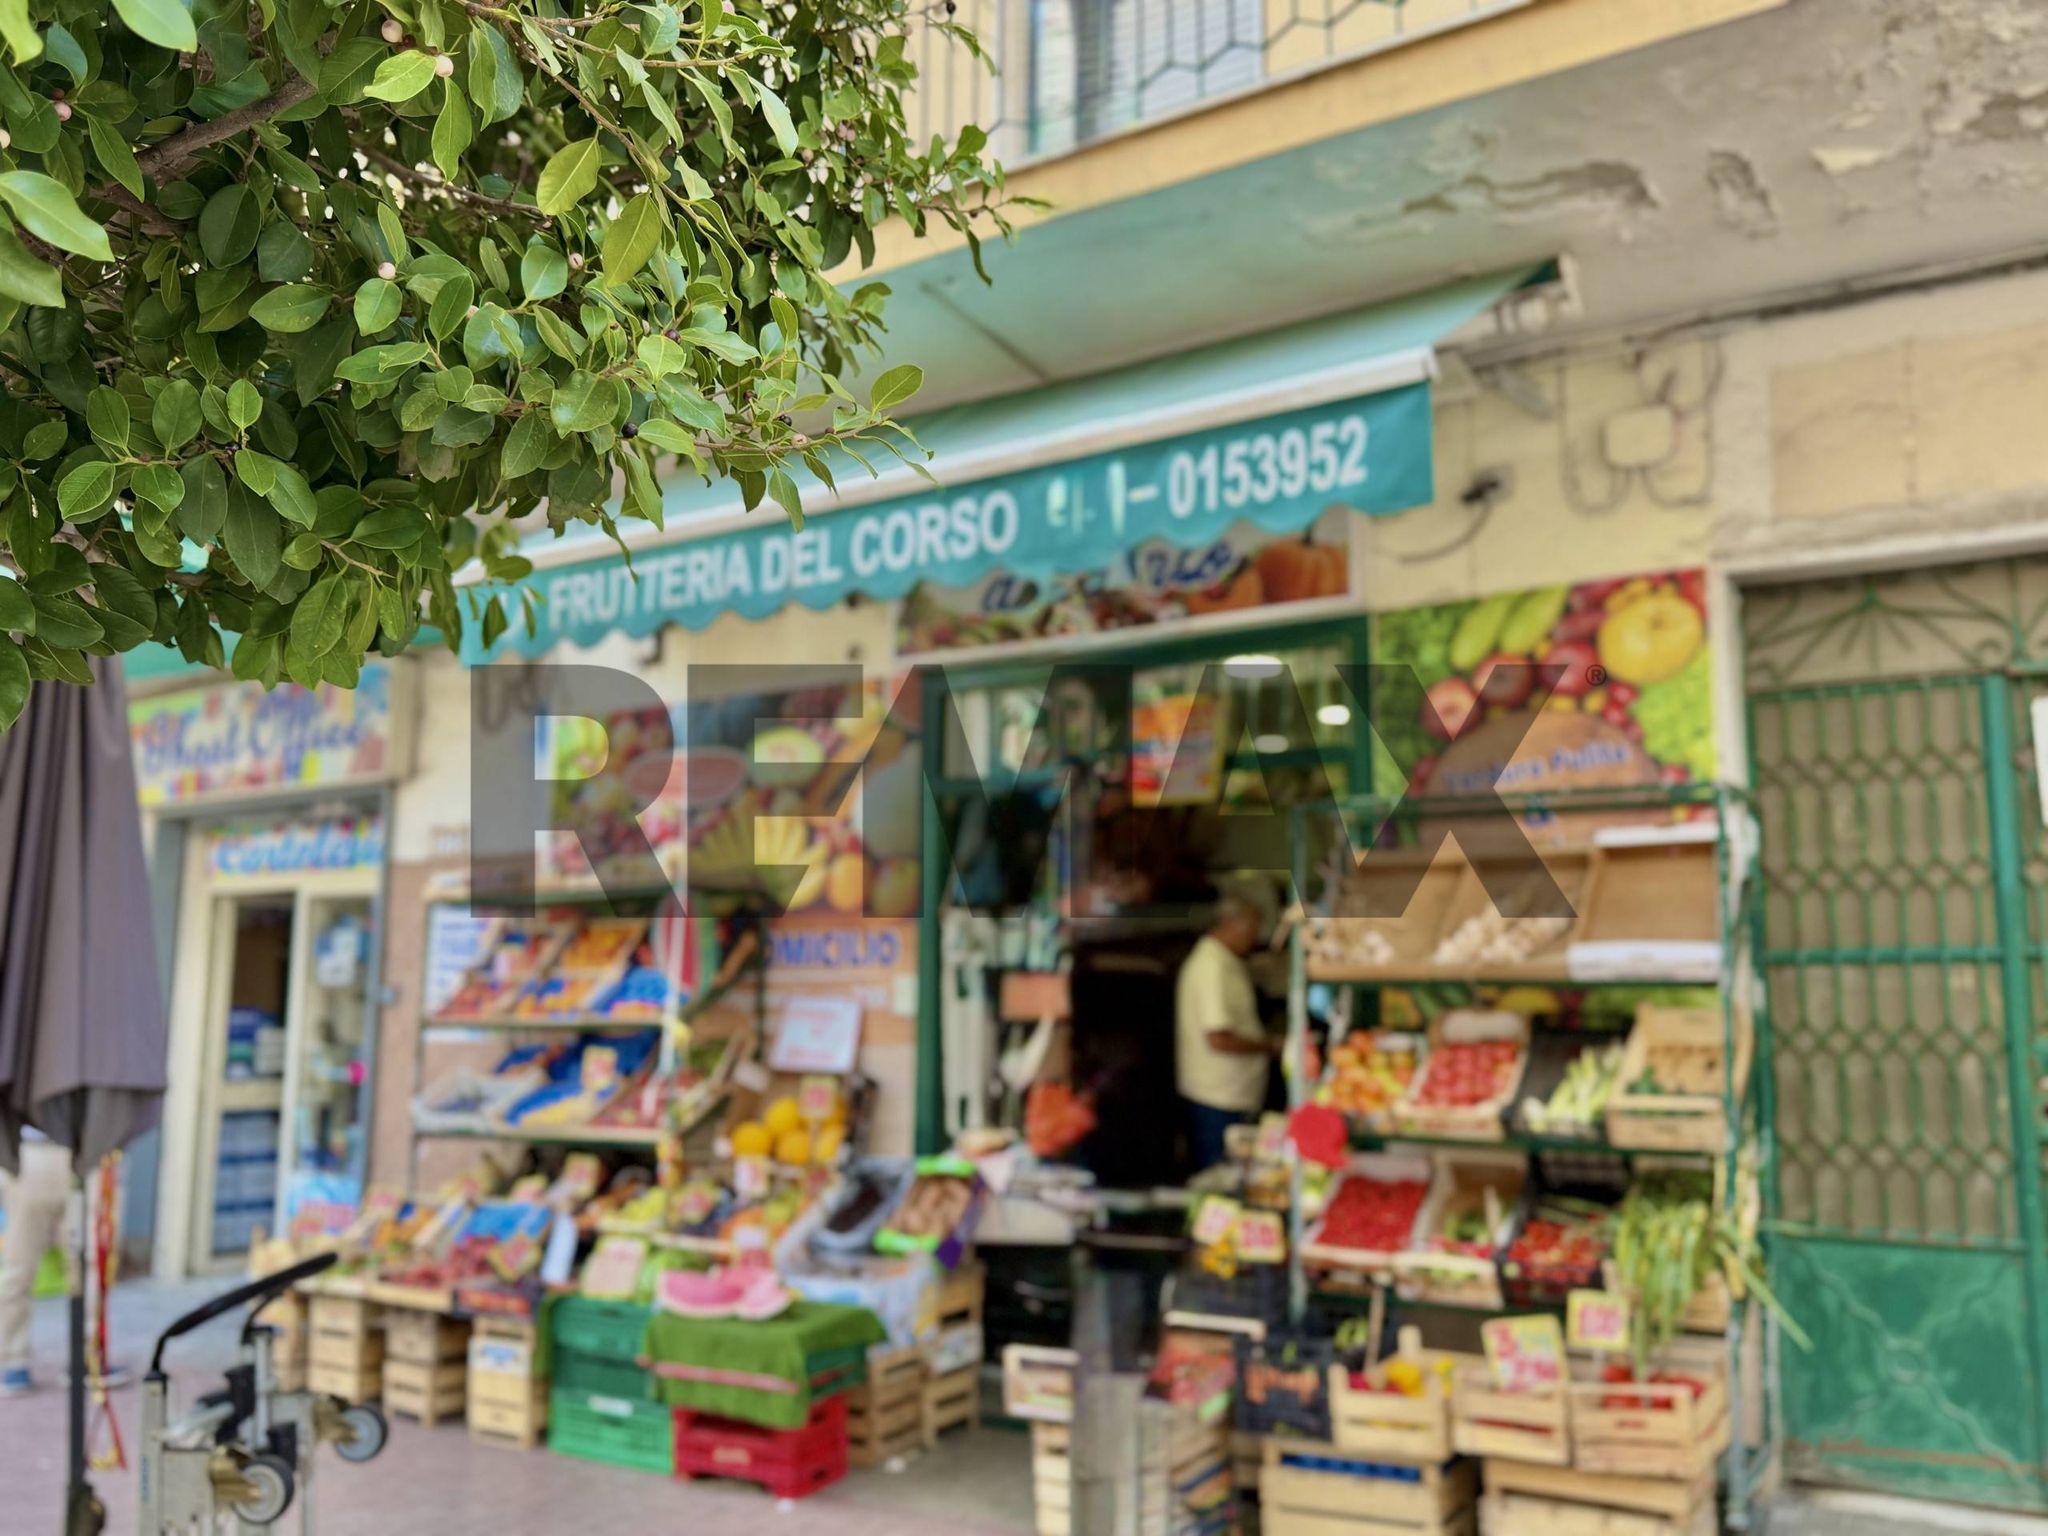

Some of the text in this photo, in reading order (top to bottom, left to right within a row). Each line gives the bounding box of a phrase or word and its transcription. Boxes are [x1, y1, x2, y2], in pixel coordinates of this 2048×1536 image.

[548, 544, 754, 632] FRUTTERIA
[762, 523, 842, 594] DEL
[850, 488, 1018, 577] CORSO
